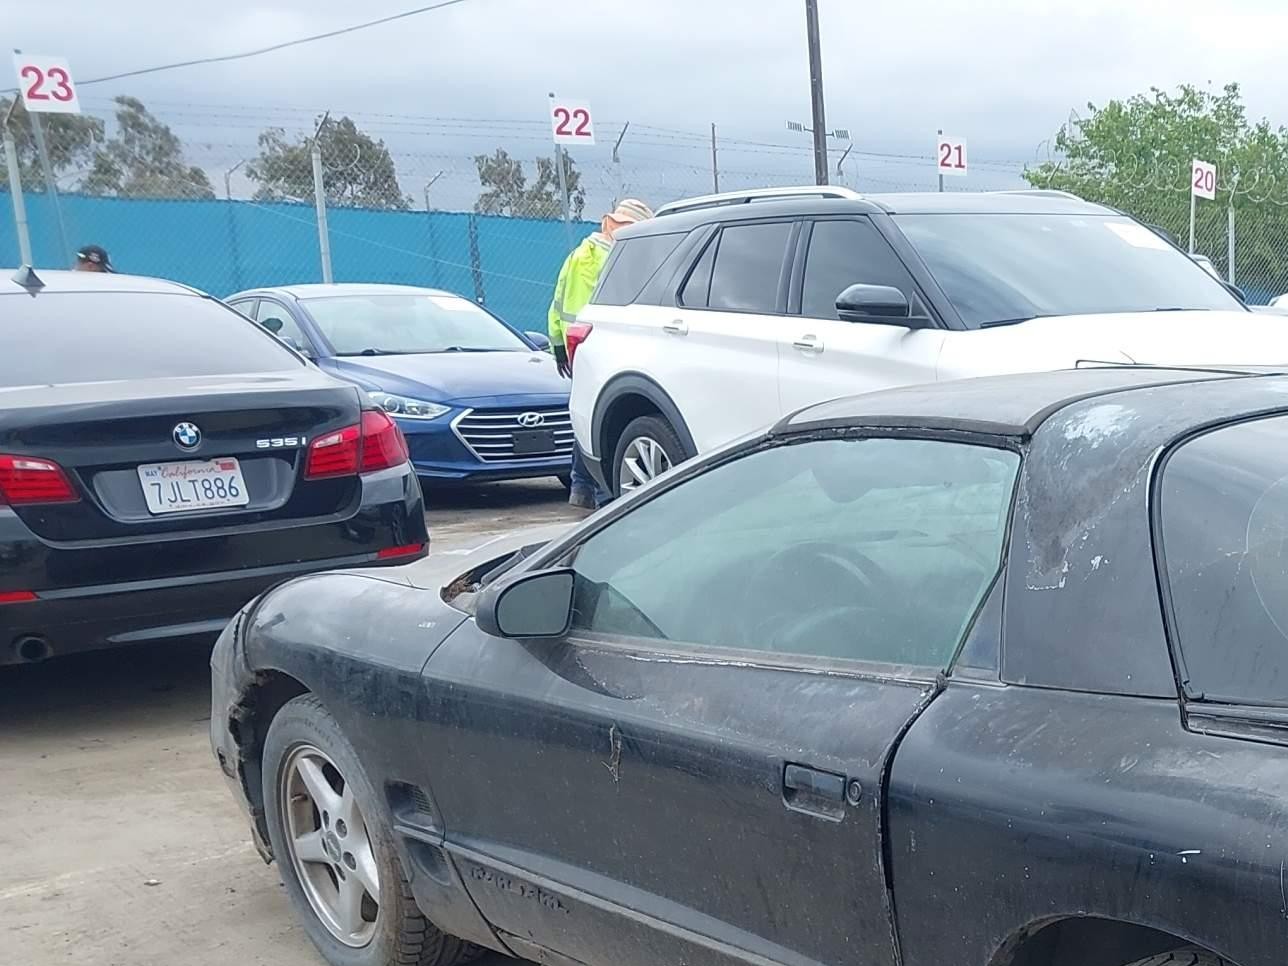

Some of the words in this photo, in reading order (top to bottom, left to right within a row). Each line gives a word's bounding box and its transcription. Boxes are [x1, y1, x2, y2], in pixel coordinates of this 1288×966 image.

[21, 65, 74, 102] 23
[553, 107, 592, 137] 22
[940, 143, 966, 169] 21
[1194, 167, 1214, 192] 20
[150, 475, 240, 505] 7JLT886
